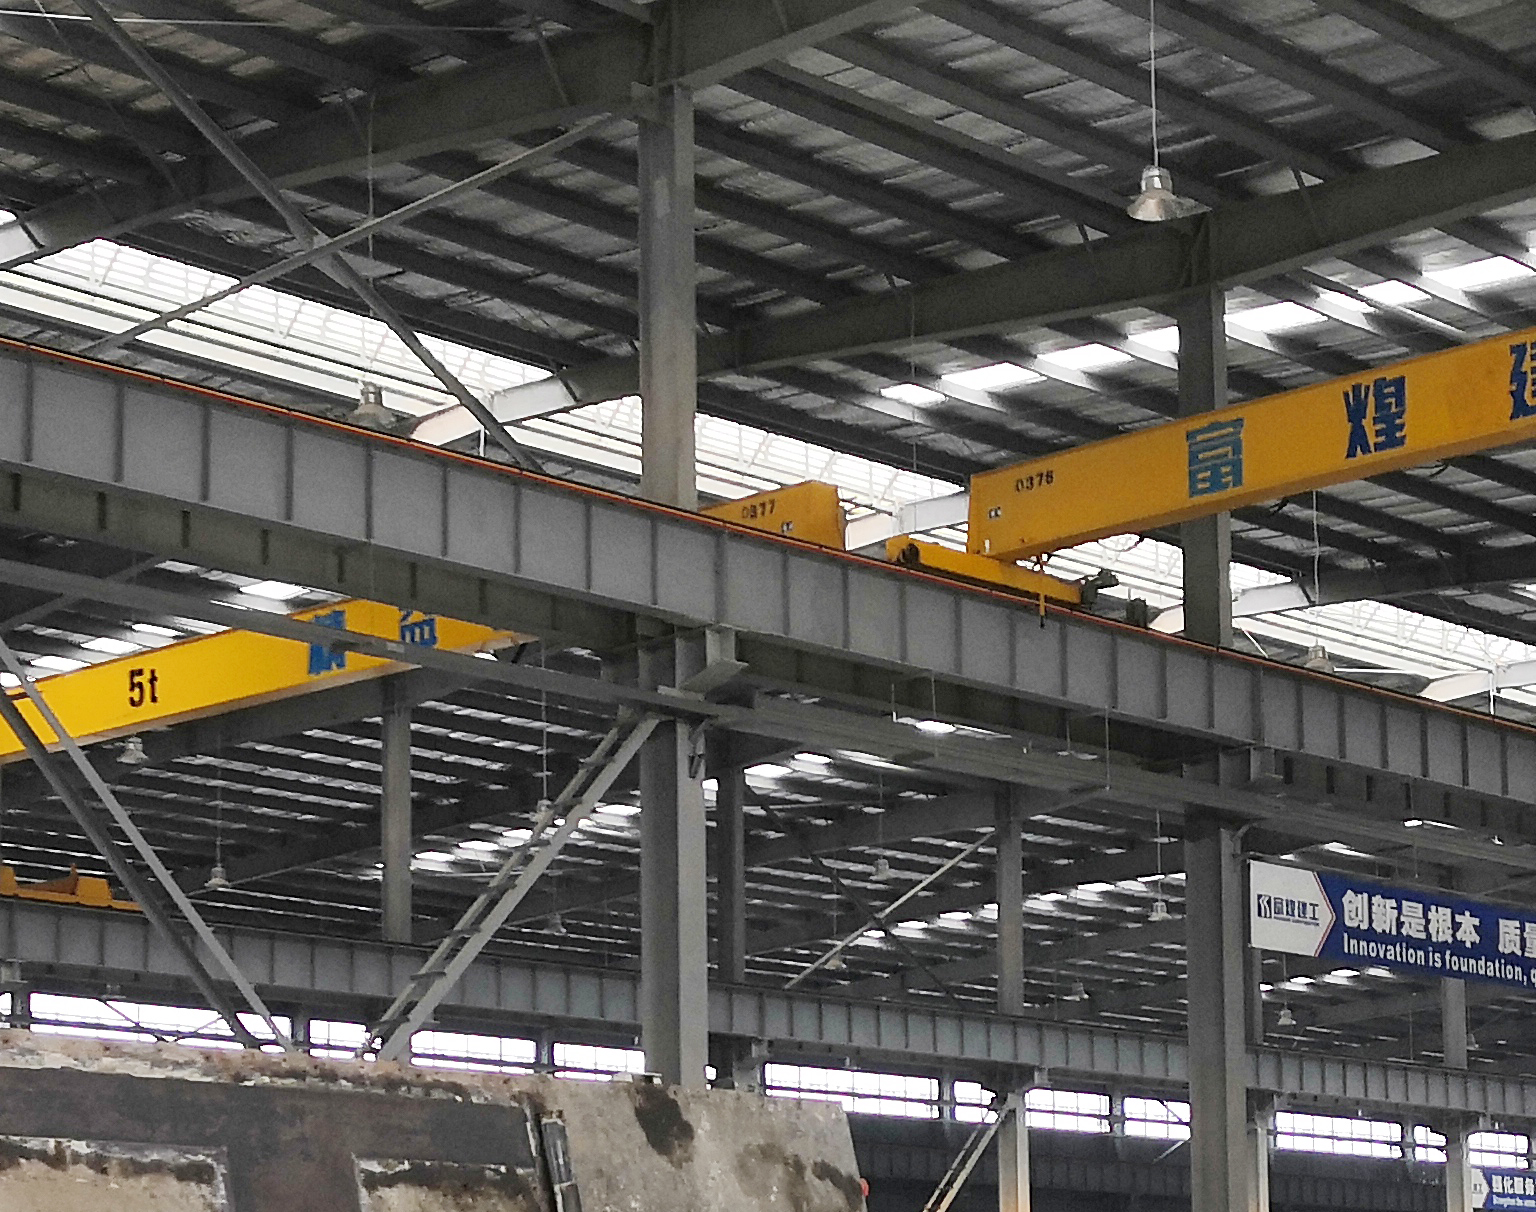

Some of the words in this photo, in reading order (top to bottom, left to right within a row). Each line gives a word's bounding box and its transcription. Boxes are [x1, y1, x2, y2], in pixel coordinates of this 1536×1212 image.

[128, 668, 159, 708] 5t
[1342, 889, 1481, 949] 创新是根本
[1343, 931, 1425, 966] Innovation
[1428, 946, 1443, 968] is
[1444, 949, 1528, 987] foundation,
